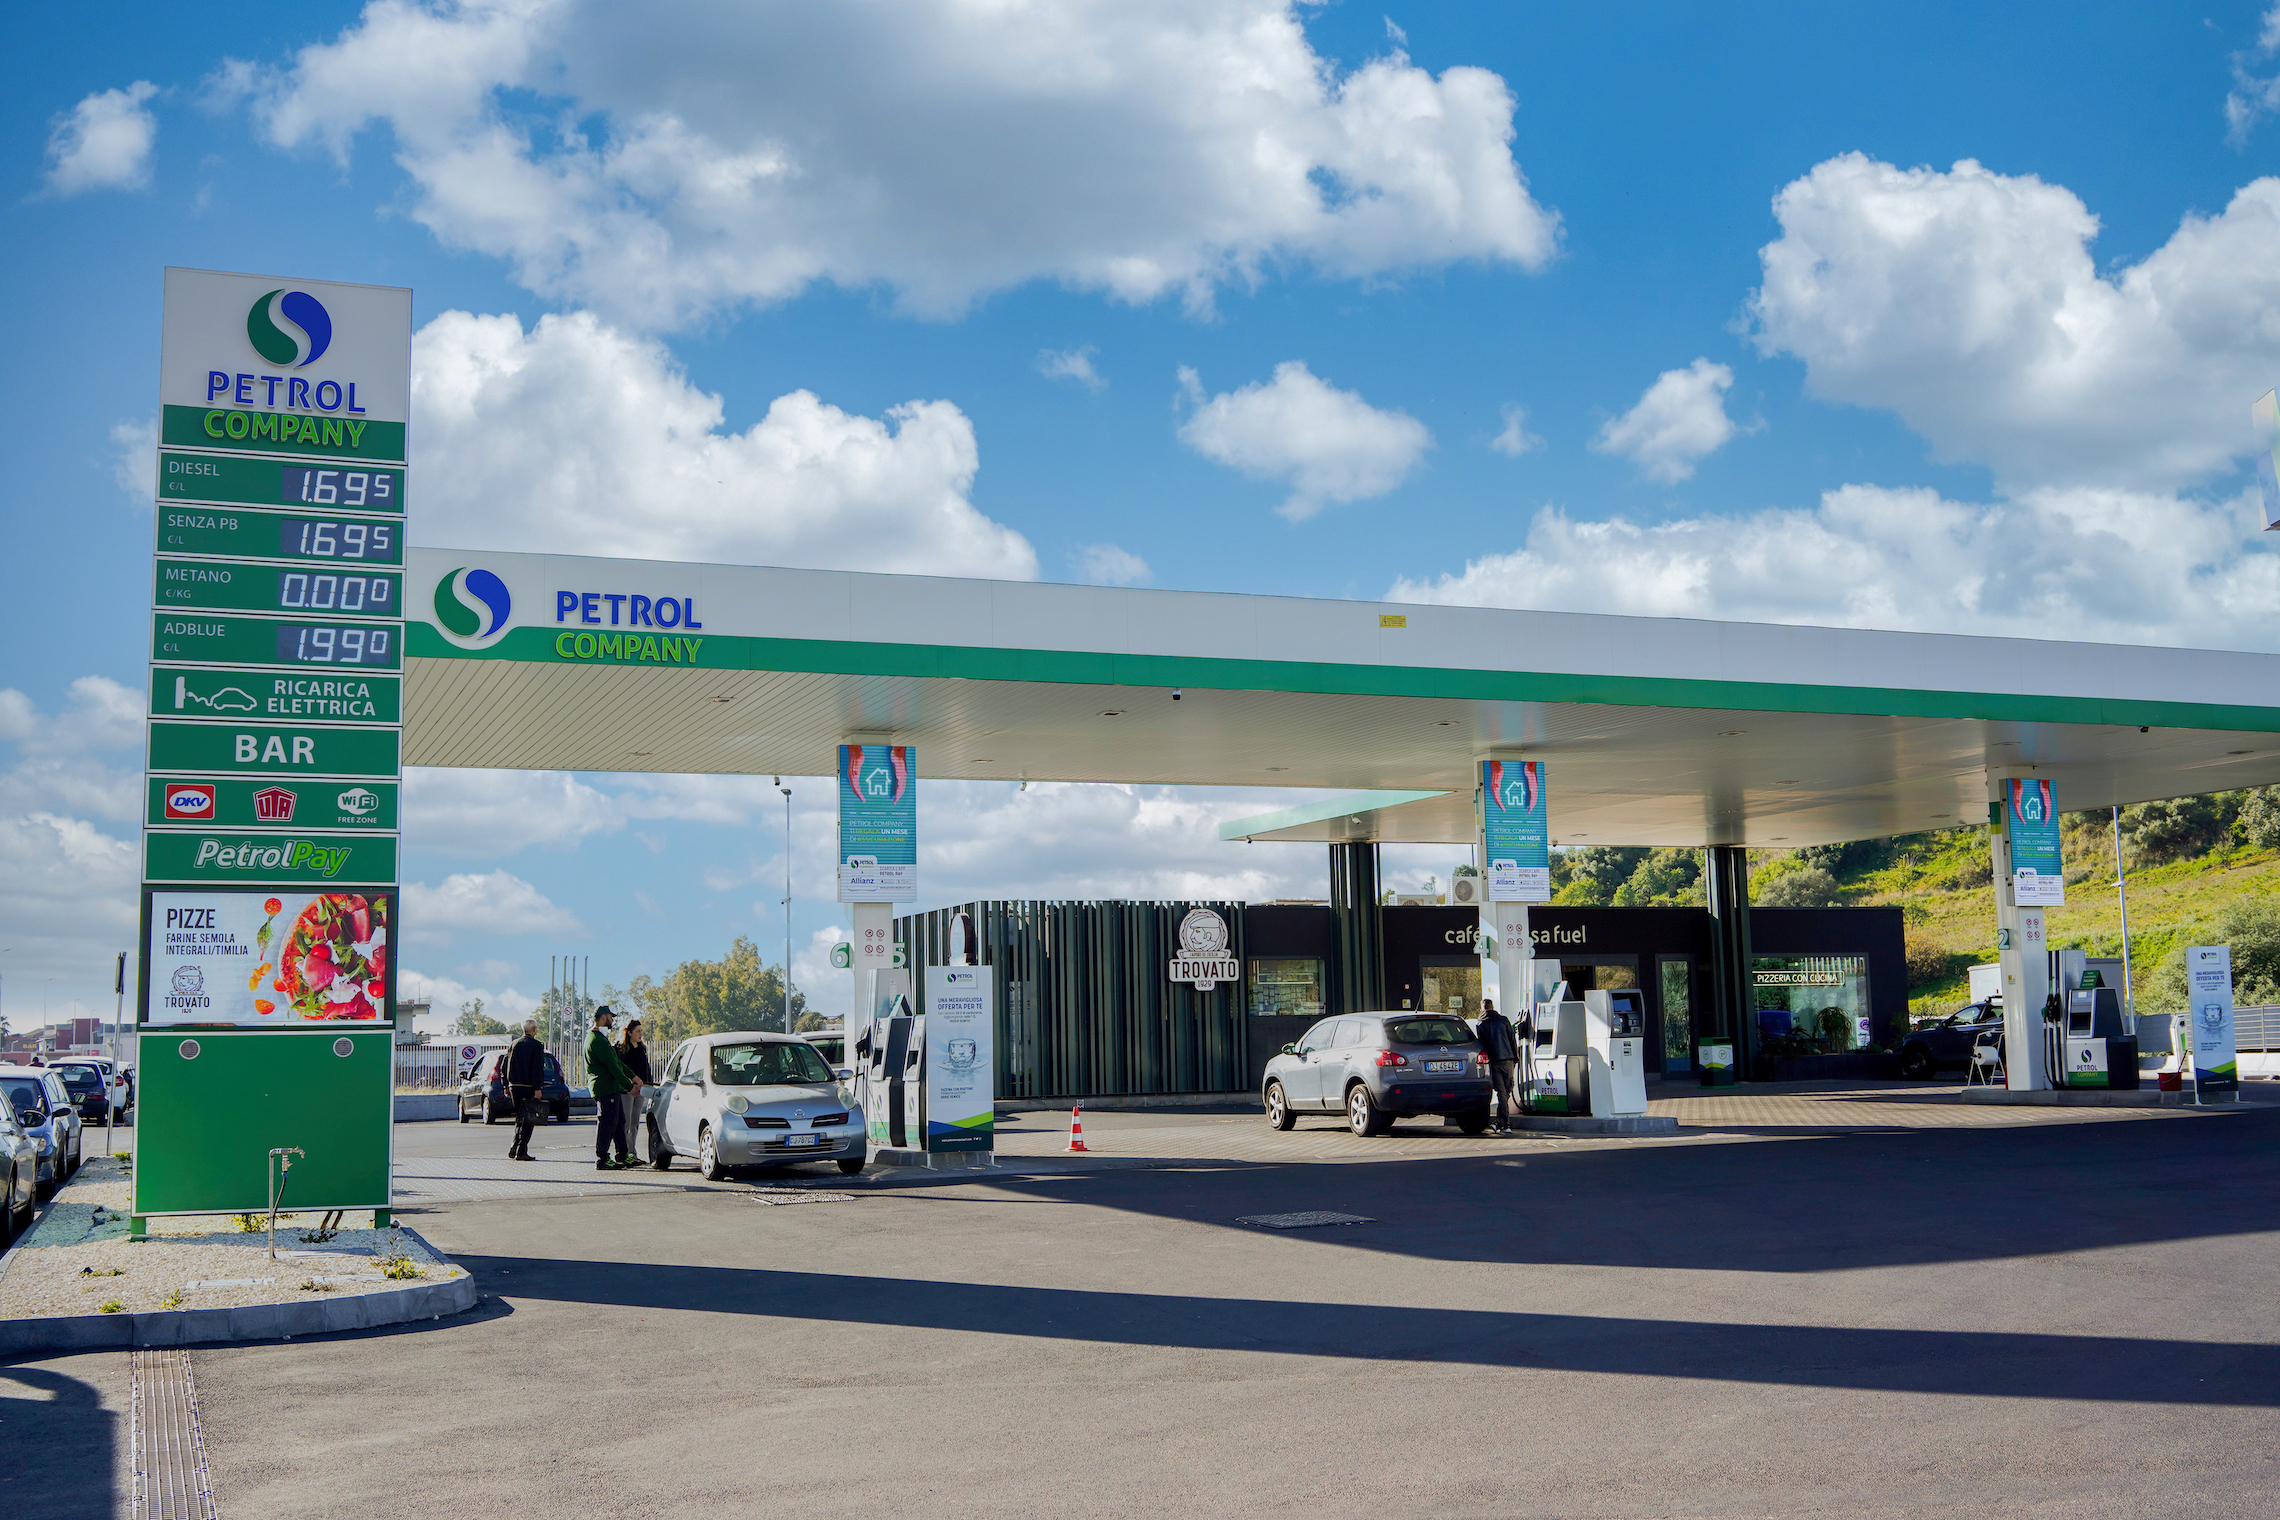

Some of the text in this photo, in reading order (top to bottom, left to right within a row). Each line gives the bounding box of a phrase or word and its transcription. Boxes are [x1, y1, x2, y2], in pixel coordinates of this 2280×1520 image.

[206, 370, 367, 415] PETROL
[204, 410, 368, 448] COMPANY
[169, 461, 220, 476] DIESEL
[169, 481, 185, 491] €/L
[301, 470, 391, 506] 1.695
[168, 514, 238, 530] SENZA PB
[167, 535, 184, 545] €/L
[300, 522, 390, 558] 1.695
[165, 568, 232, 583] METANO
[165, 588, 191, 599] €/KG
[281, 573, 389, 611] 0.000
[555, 590, 702, 629] PETROL
[164, 622, 226, 637] ADBLUE
[163, 642, 180, 652] €/L
[298, 628, 388, 663] 1.990
[555, 632, 703, 663] COMPANY
[274, 680, 370, 698] RICARICA
[267, 697, 376, 716] ELETTRICA
[235, 734, 315, 765] BAR
[174, 797, 208, 807] DKV
[194, 838, 352, 878] PetrolPay
[167, 908, 216, 928] PIZZE
[166, 933, 235, 943] FARINE SEMOLA
[1553, 925, 1586, 944] fuel
[1997, 929, 2009, 950] 2
[166, 945, 248, 955] INTEGRALI/TIMILIA
[830, 942, 850, 968] 6
[893, 942, 907, 968] 5
[1473, 935, 1490, 959] 4
[1172, 961, 1236, 978] TROVATO
[1757, 974, 1838, 983] PIZZERIA CON CUCINA
[164, 996, 210, 1008] TROVATO
